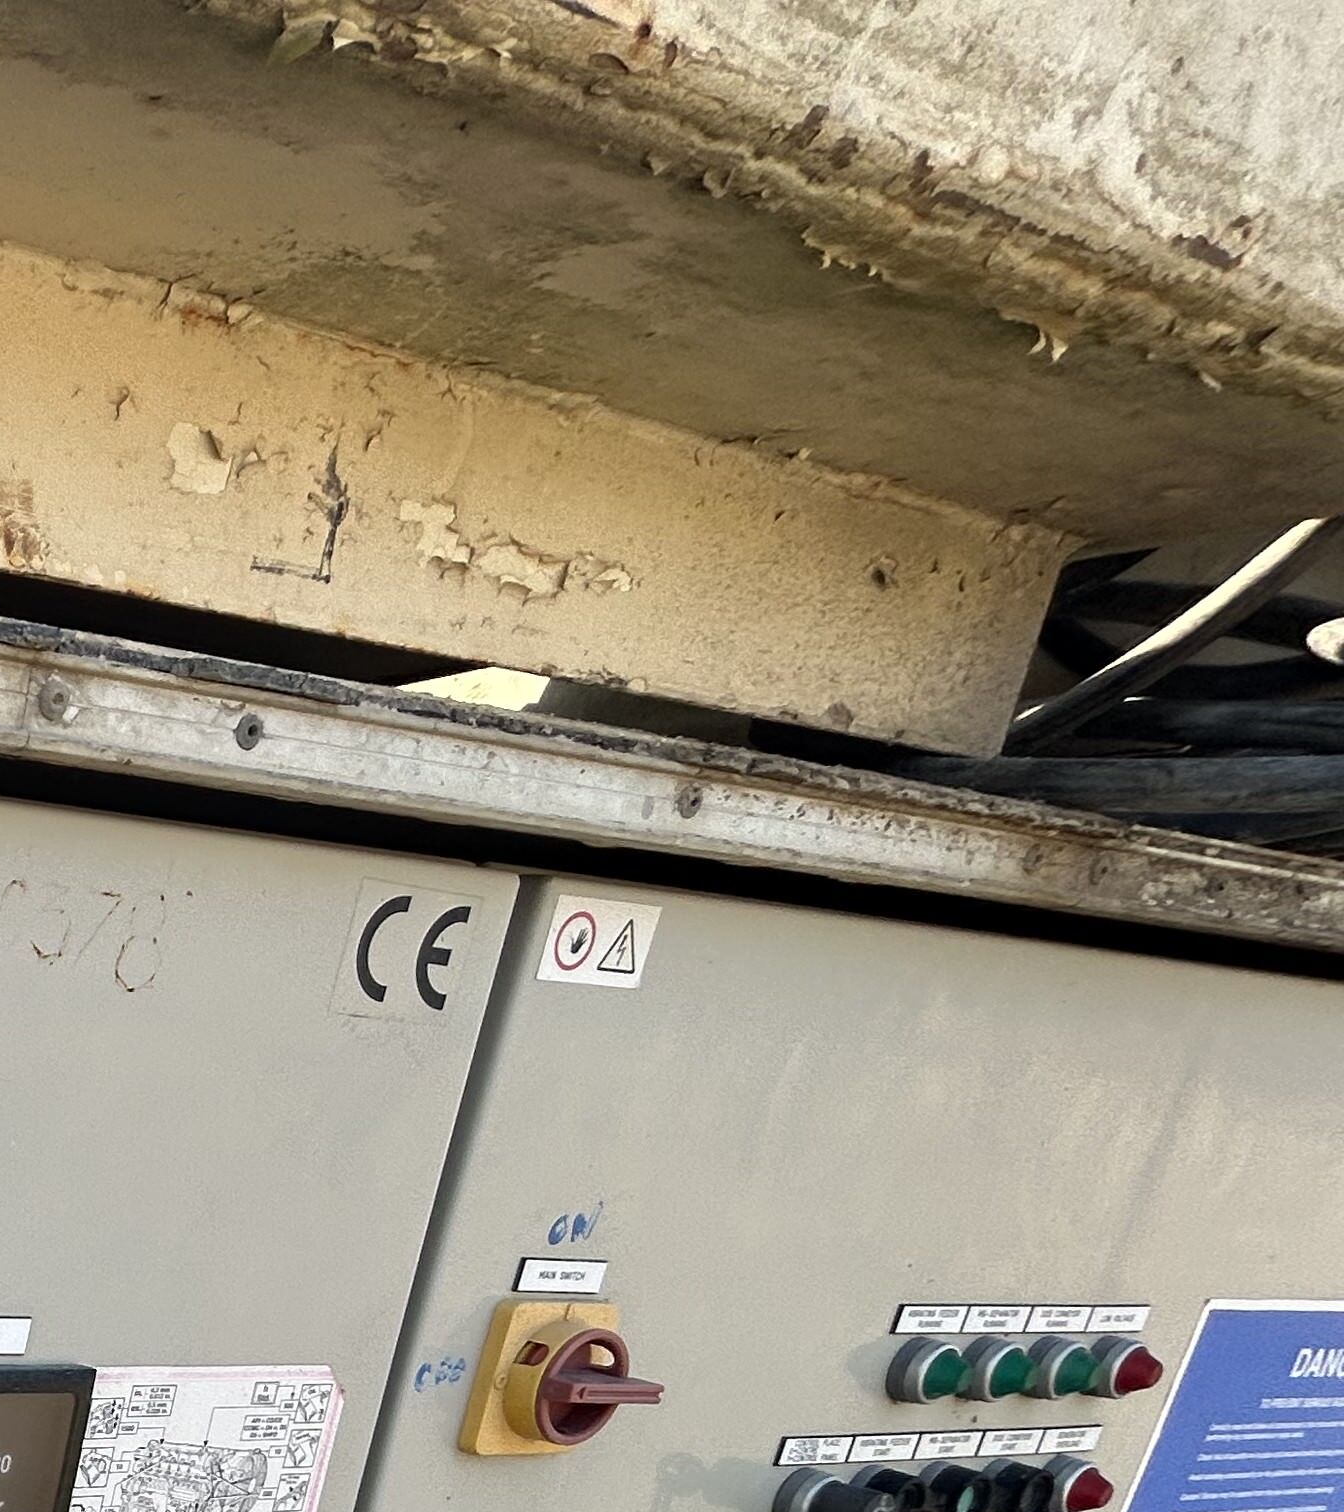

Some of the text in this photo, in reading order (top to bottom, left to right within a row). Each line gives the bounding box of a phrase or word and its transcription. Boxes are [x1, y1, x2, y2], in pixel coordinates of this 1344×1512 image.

[356, 895, 472, 1011] CE
[538, 1270, 586, 1281] MAIN SWITCH
